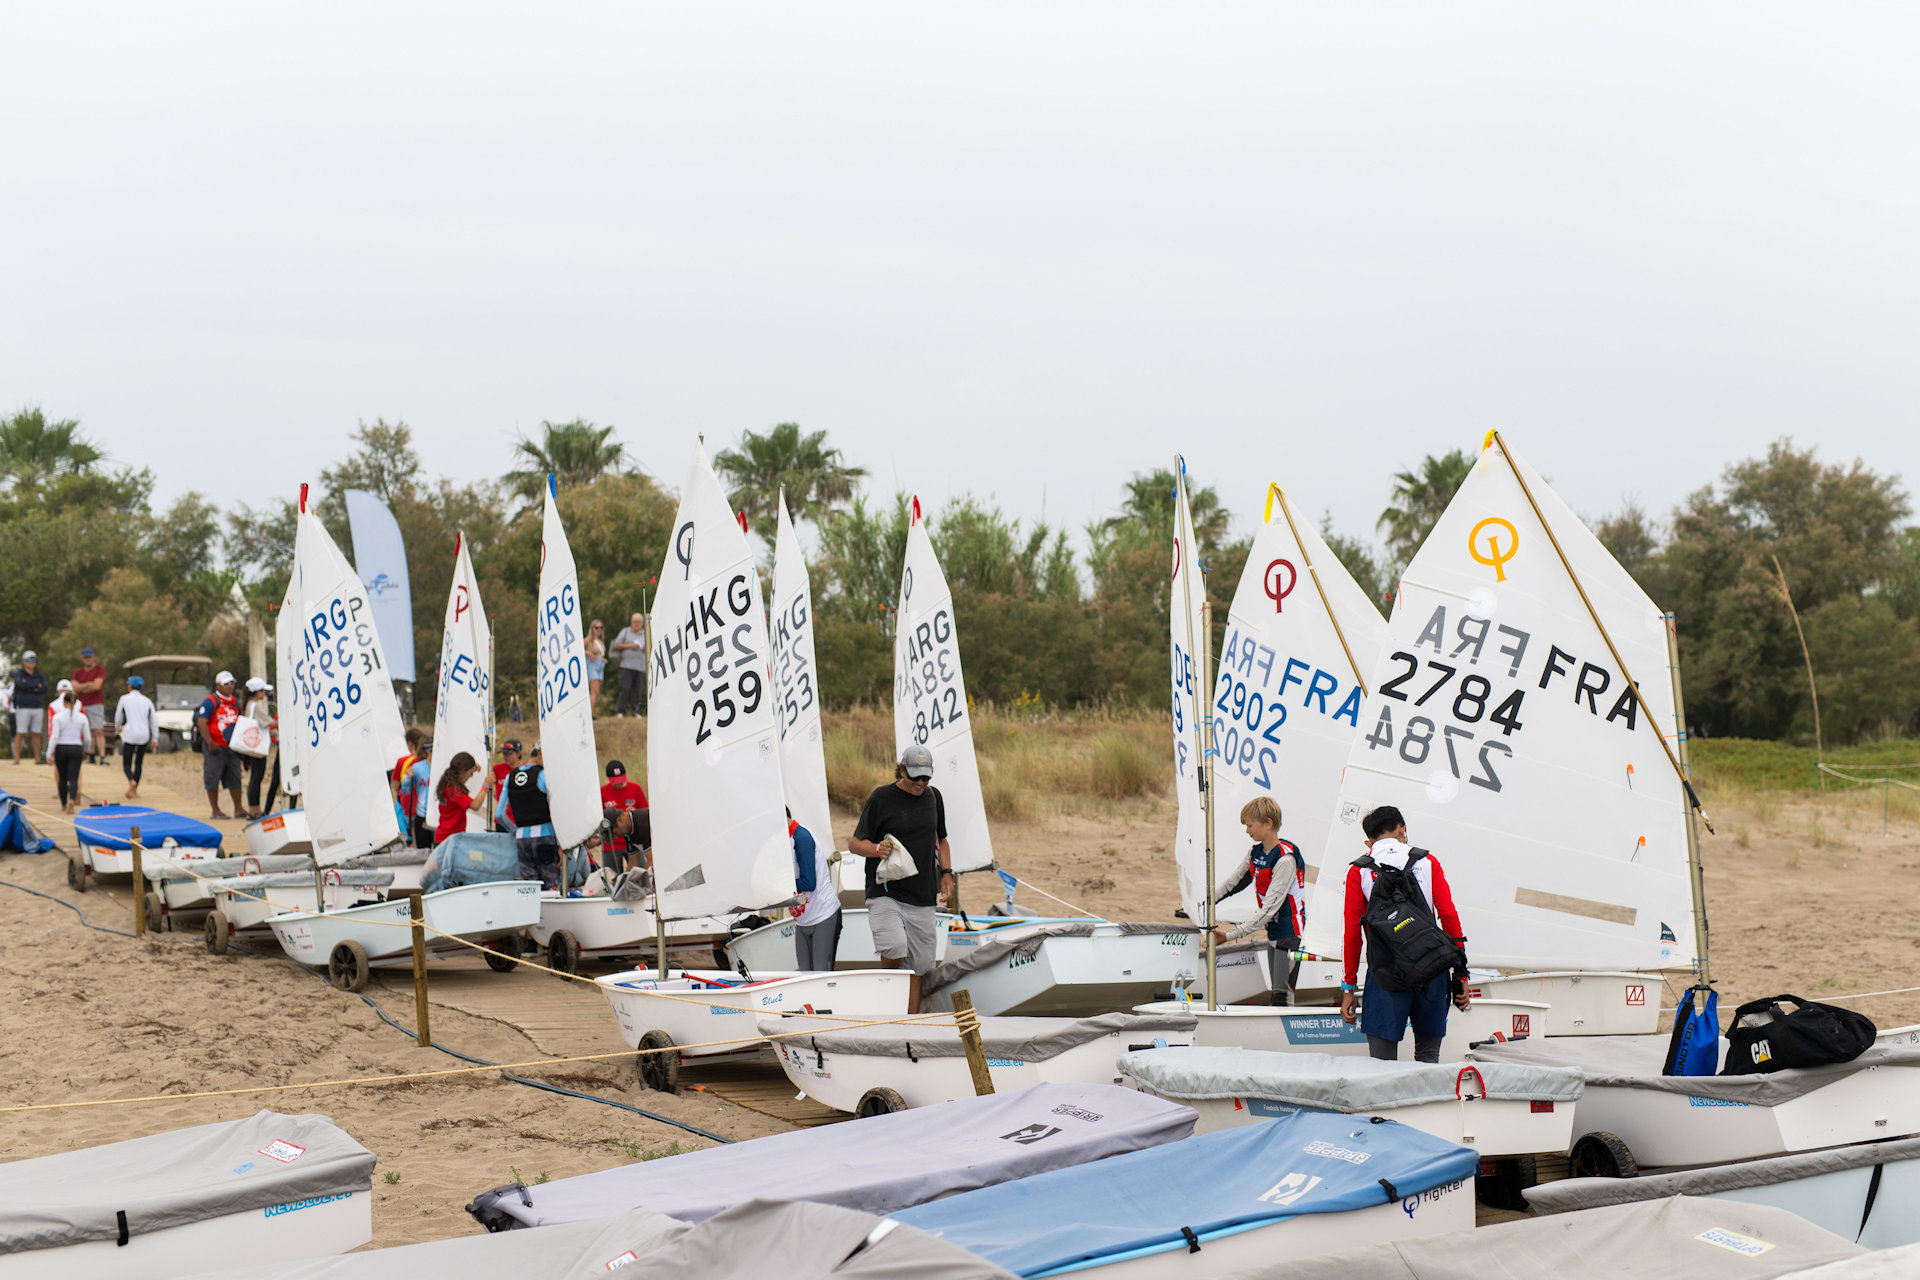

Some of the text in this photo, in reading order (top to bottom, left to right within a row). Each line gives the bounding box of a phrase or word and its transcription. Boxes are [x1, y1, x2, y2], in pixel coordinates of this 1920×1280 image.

[304, 599, 347, 662] ARG
[685, 575, 751, 650] HKG
[908, 610, 950, 669] ARG
[450, 654, 489, 692] ESP
[540, 656, 581, 722] 4020
[692, 670, 762, 746] 259
[778, 672, 813, 743] 253
[1278, 657, 1363, 728] FRA
[1378, 651, 1526, 736] 2784
[1538, 644, 1640, 731] FRA
[308, 672, 361, 748] 3936
[1216, 673, 1287, 745] 2902
[1289, 1018, 1344, 1029] WINNER TEAM
[1750, 1039, 1772, 1065] CAT
